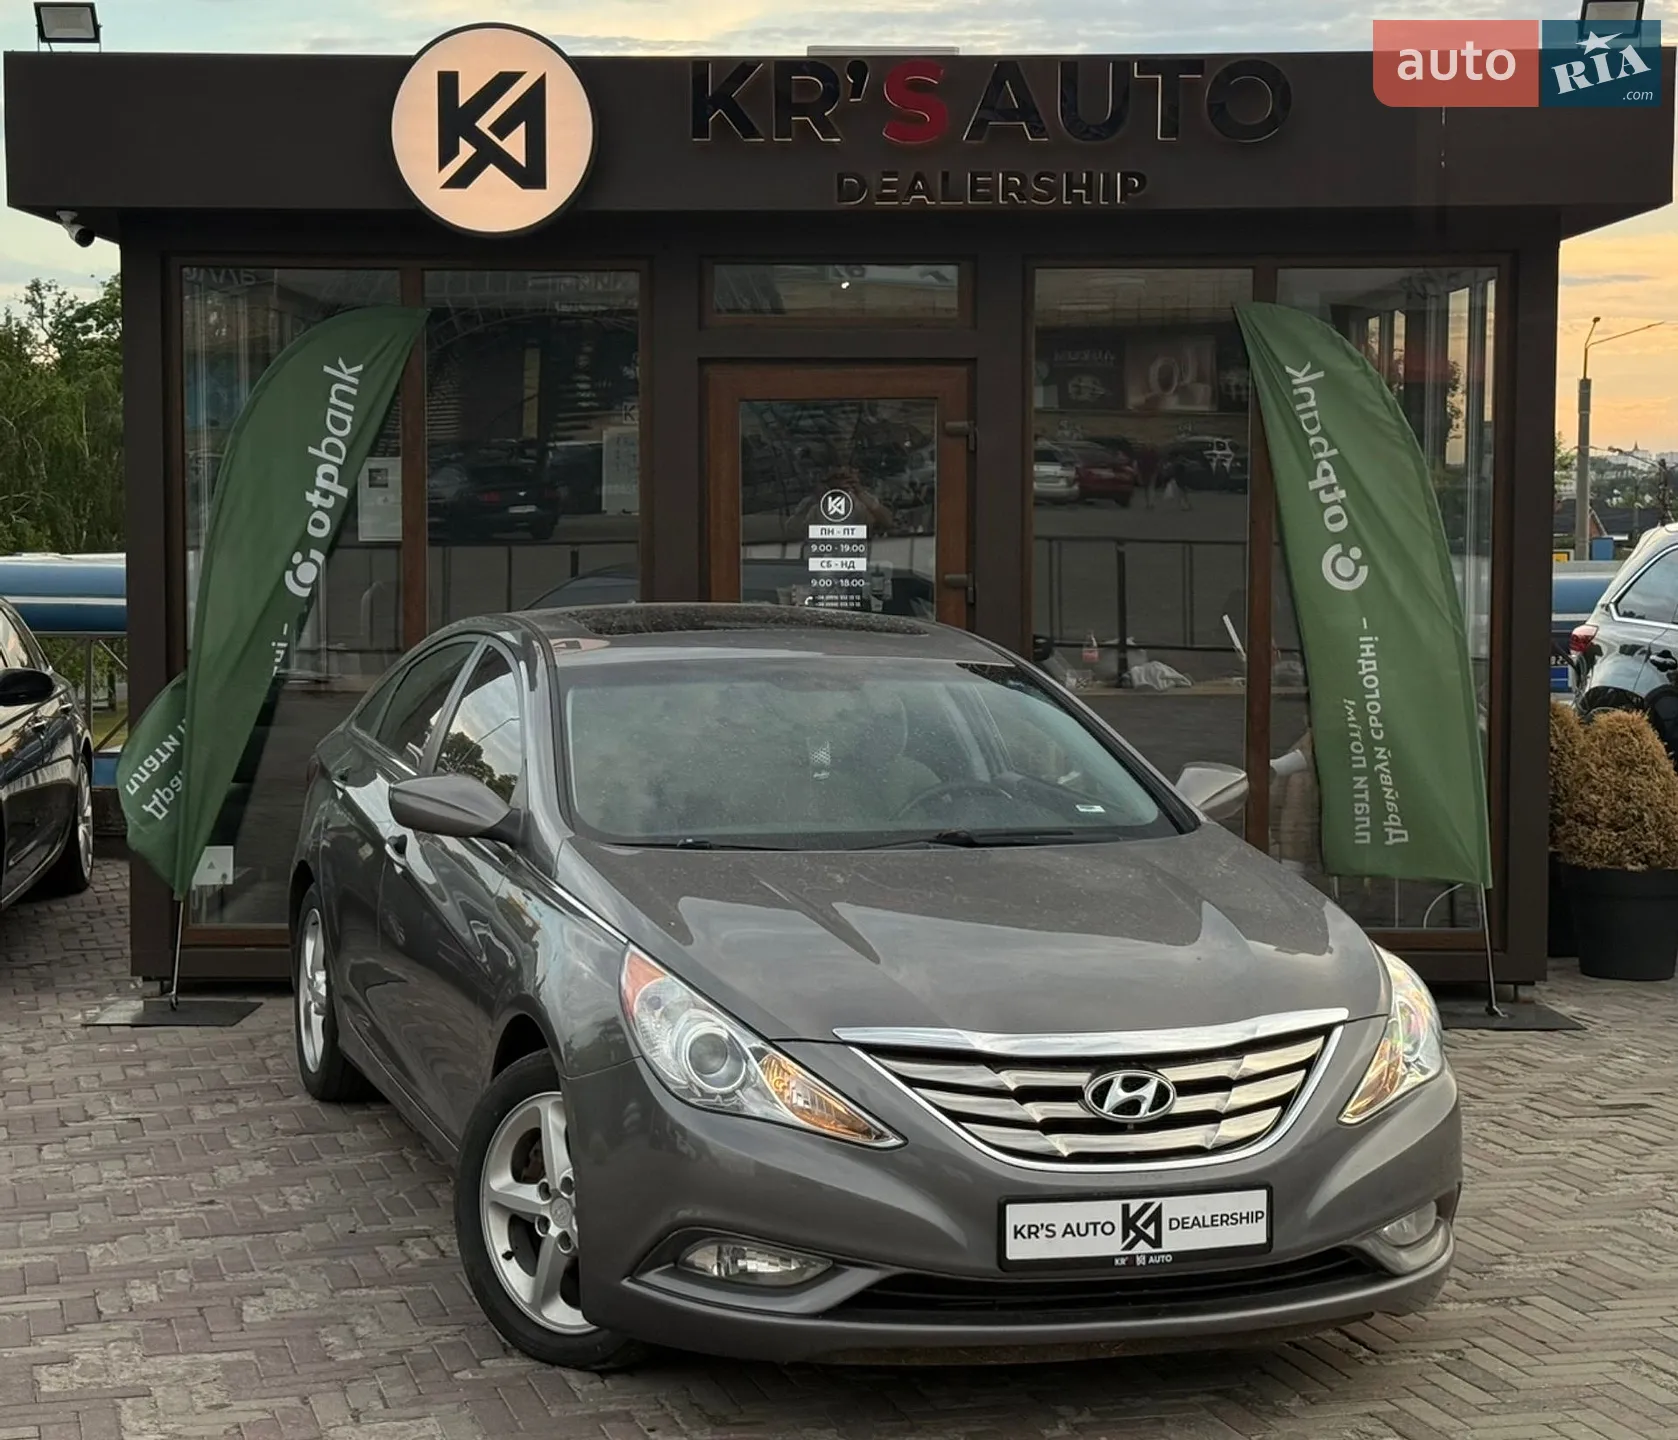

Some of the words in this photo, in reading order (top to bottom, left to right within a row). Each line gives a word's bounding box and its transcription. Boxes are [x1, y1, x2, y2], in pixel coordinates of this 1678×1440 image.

[691, 58, 949, 144] KR'S
[962, 58, 1293, 143] AUTO
[836, 170, 1148, 206] DEALERSHIP
[305, 356, 364, 539] otpbank
[820, 527, 835, 536] ПН
[843, 527, 856, 536] ПТ
[820, 560, 833, 569] СБ
[840, 560, 856, 570] НД
[1013, 1222, 1057, 1240] KR'S
[1061, 1220, 1116, 1239] AUTO
[1167, 1210, 1265, 1231] DEALERSHIP
[1148, 1253, 1173, 1265] AUTO
